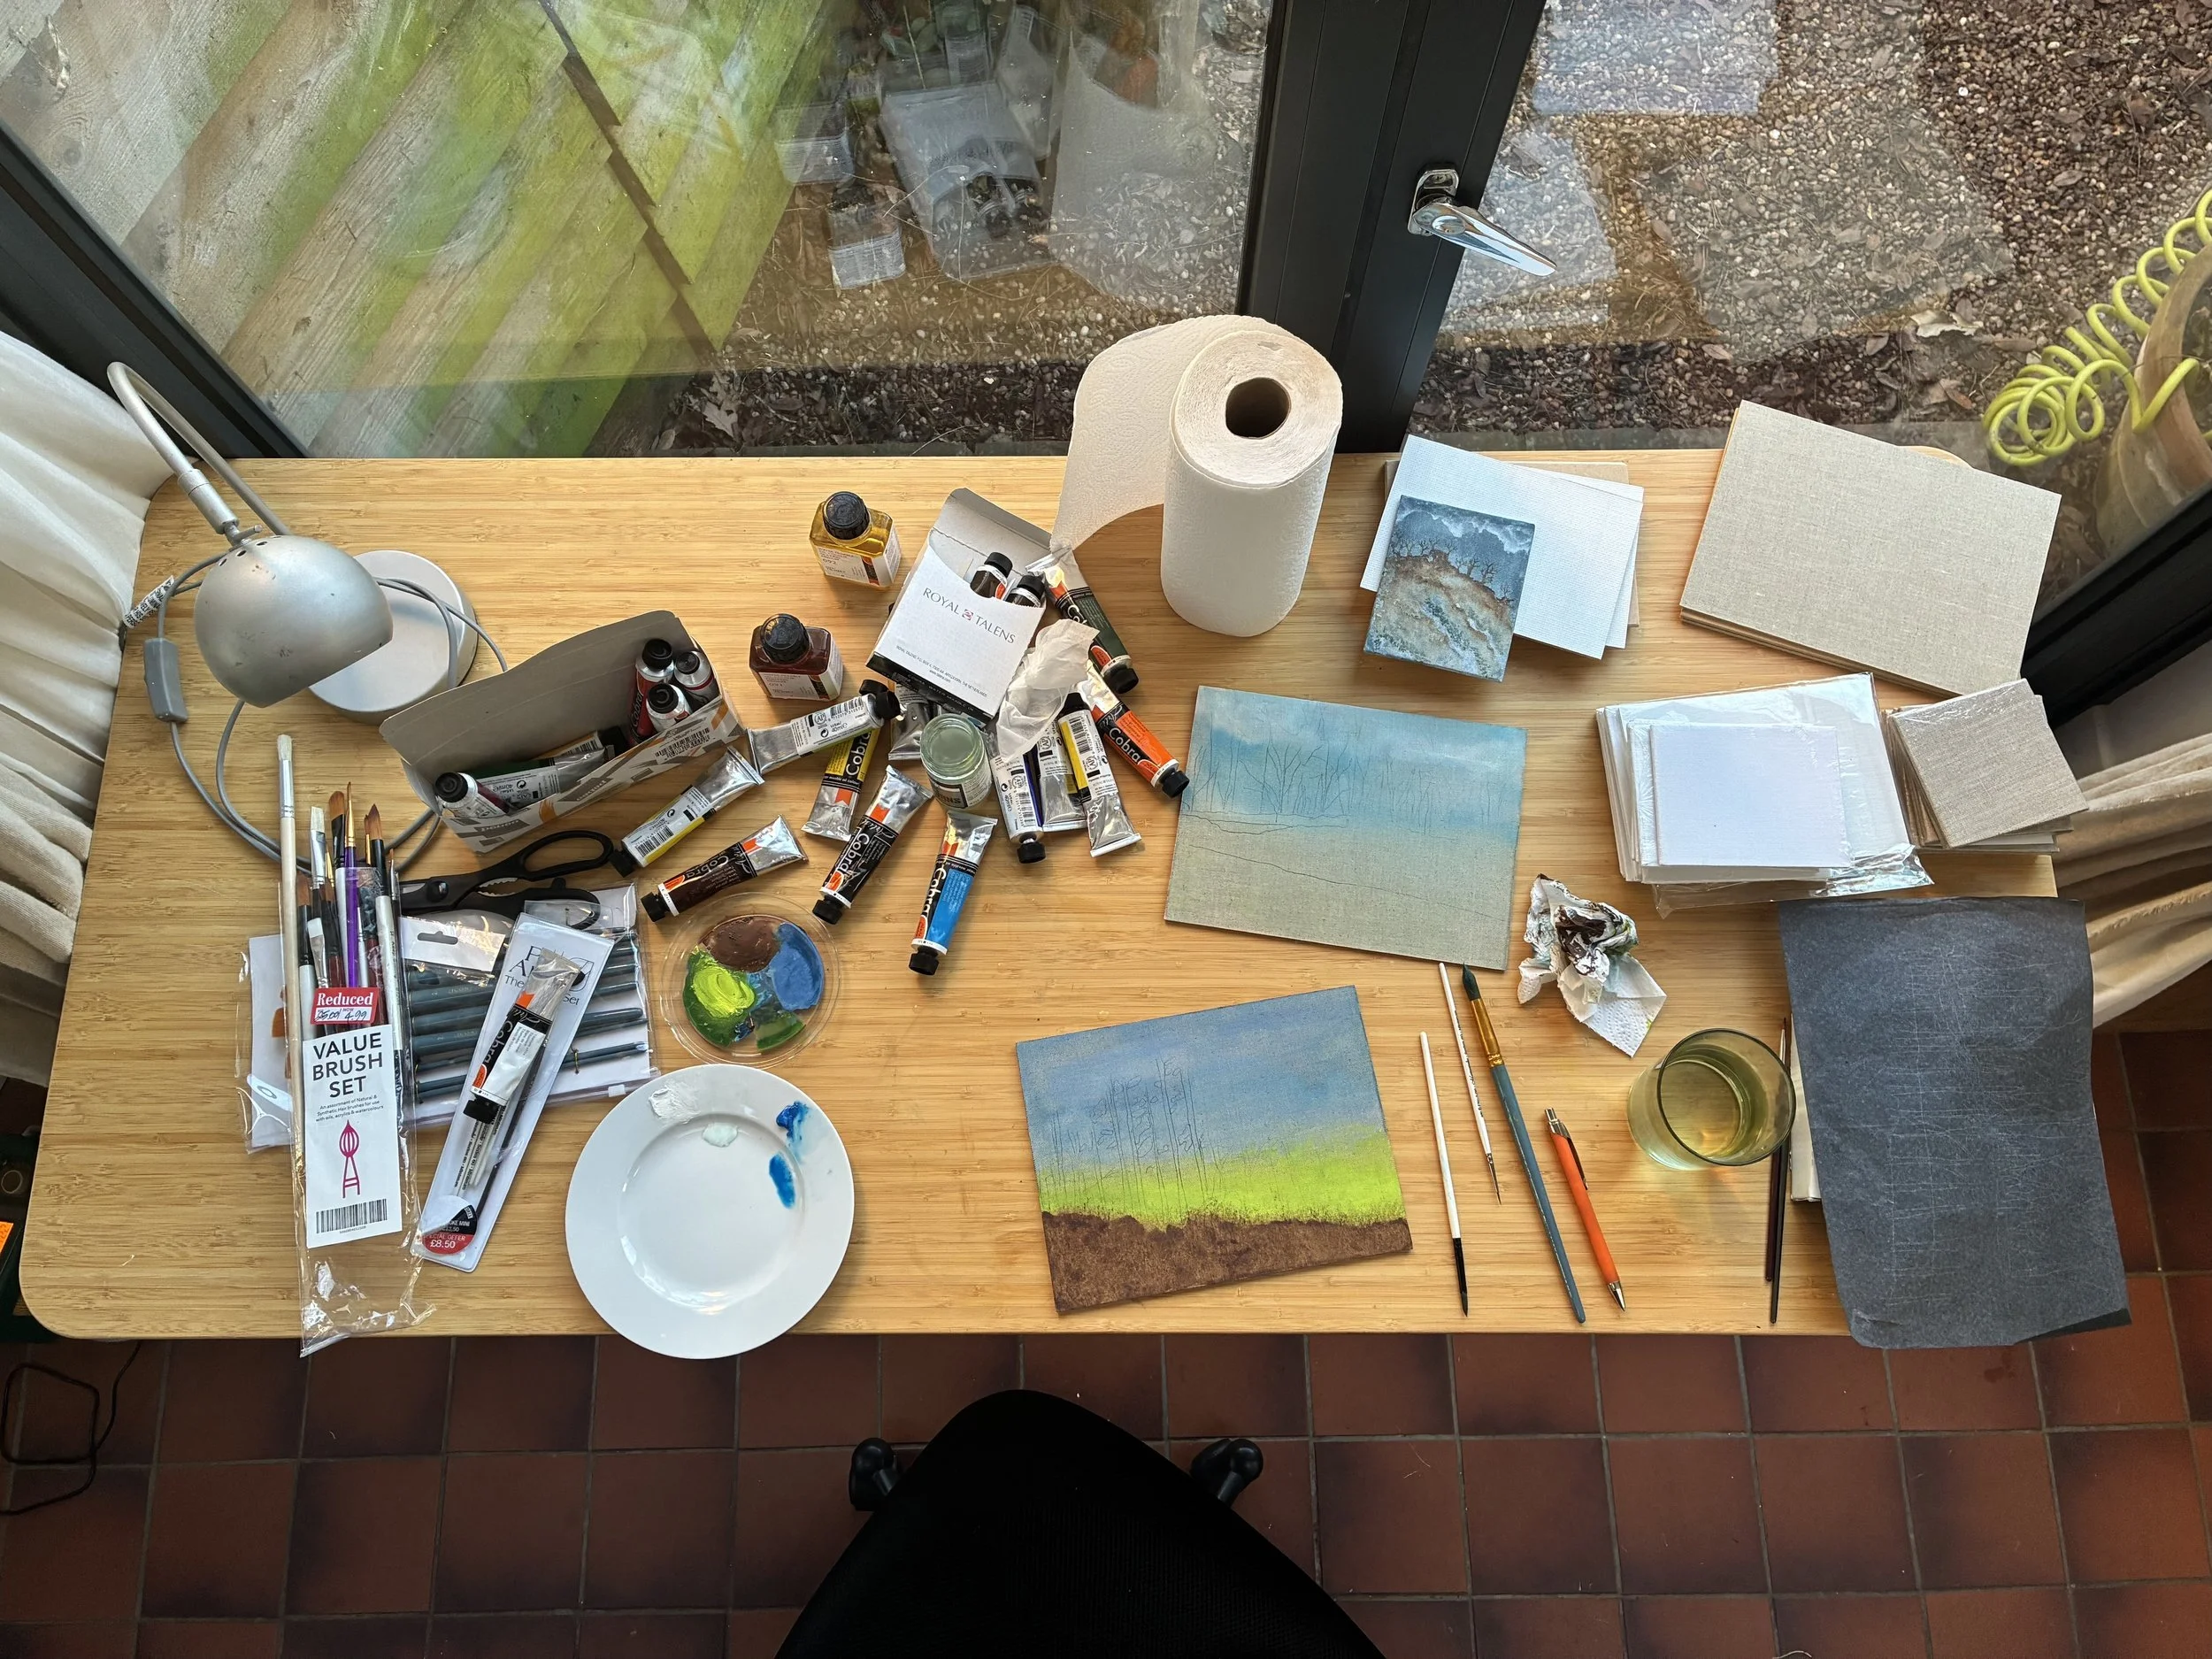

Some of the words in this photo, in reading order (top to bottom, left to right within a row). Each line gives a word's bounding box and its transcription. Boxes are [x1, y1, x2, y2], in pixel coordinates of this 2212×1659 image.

[922, 588, 960, 615] ROYAL
[974, 615, 1016, 644] TALENS
[845, 732, 871, 776] Cobra
[1109, 727, 1141, 763] Cobra
[687, 855, 729, 879] Cobra
[839, 833, 870, 872] Cobra
[923, 868, 947, 914] Cobra
[317, 992, 374, 1006] Reduced
[504, 974, 525, 988] The
[563, 993, 580, 1005] Set
[312, 1032, 382, 1060] VALUE
[484, 1020, 513, 1064] Cobra
[312, 1052, 383, 1081] BRUSH
[329, 1075, 367, 1098] SET
[429, 1239, 457, 1248] £8.50
